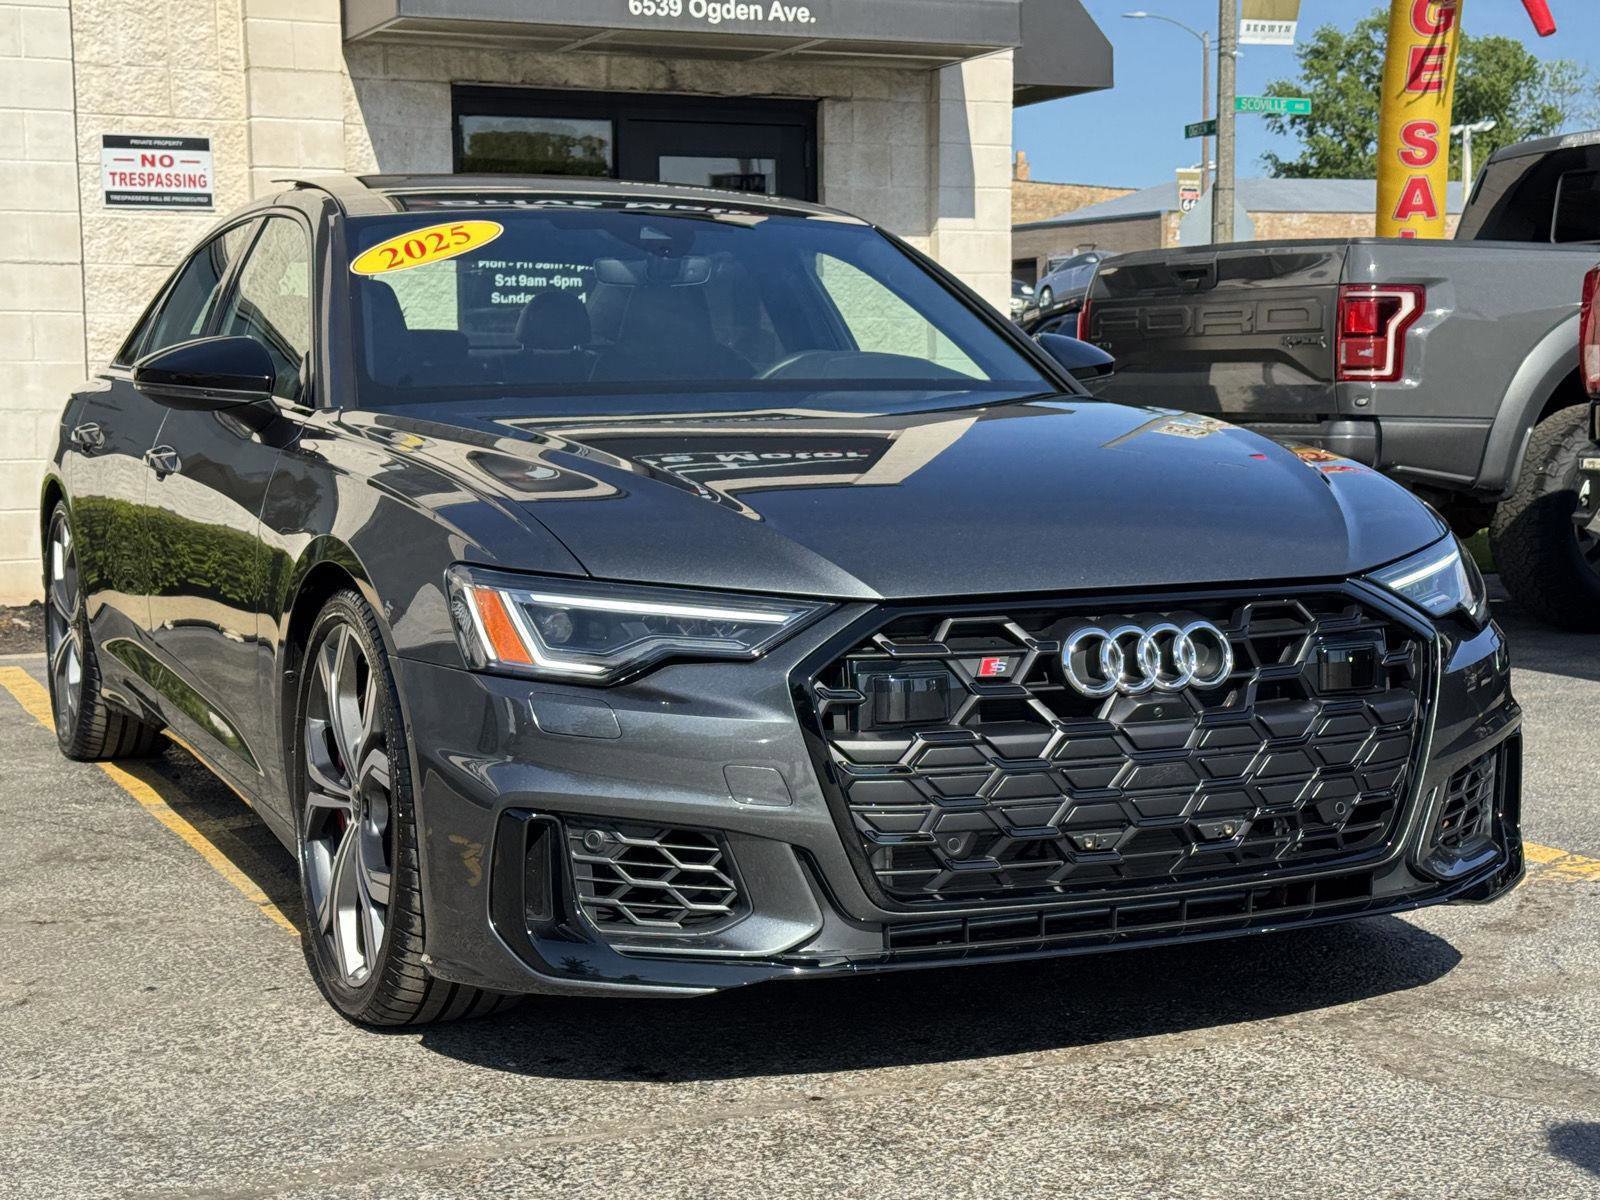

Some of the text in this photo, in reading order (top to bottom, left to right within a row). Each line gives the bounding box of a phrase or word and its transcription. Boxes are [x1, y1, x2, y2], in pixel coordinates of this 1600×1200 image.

[628, 0, 817, 24] 6539 Ogden Ave.
[1245, 23, 1292, 34] BERWYN
[1240, 97, 1287, 112] SCOVILLE
[154, 139, 184, 147] PROPERTY
[140, 153, 175, 168] NO
[109, 171, 208, 189] TRESPASSING
[1392, 119, 1439, 239] SA
[378, 225, 472, 269] 2025
[494, 273, 518, 287] Sat
[518, 274, 547, 287] 9am
[1091, 299, 1327, 339] FORD
